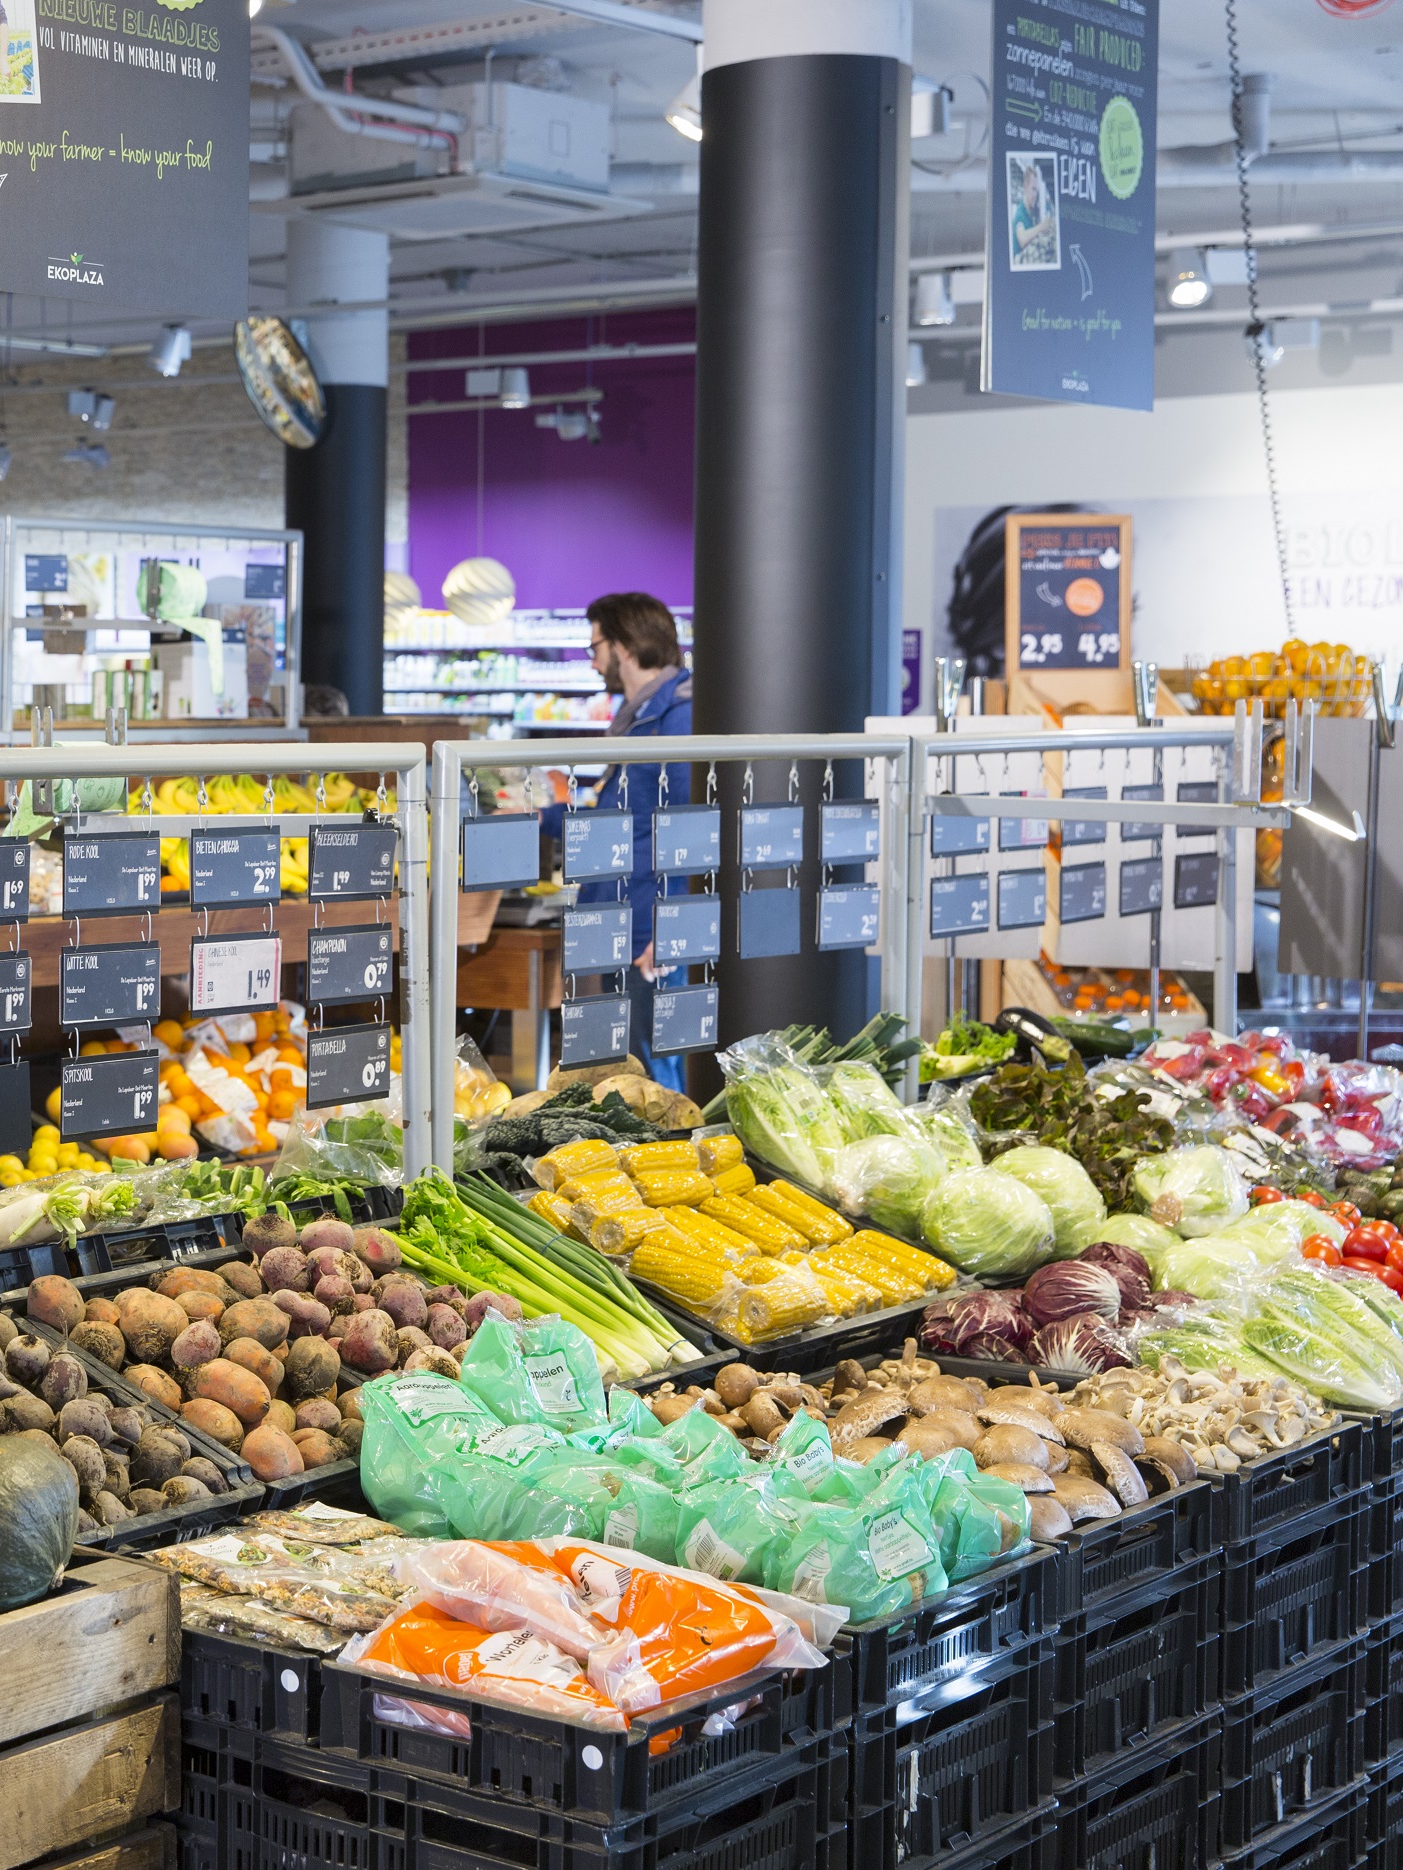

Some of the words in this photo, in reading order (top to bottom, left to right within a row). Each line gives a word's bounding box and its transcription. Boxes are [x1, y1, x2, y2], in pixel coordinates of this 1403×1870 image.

[123, 8, 220, 52] BLAADJES
[39, 27, 55, 49] VOL
[60, 31, 109, 60] VITAMINEN
[114, 42, 124, 64] EN
[128, 45, 176, 73] MINERALEN
[181, 57, 201, 79] WEER
[206, 61, 219, 82] OP.
[28, 144, 57, 171] your
[59, 130, 104, 161] farmer
[120, 133, 151, 166] know
[155, 149, 182, 179] your
[185, 140, 212, 171] food
[1059, 154, 1097, 205] EIGEN
[48, 266, 104, 285] EKOPLAZA
[1020, 633, 1063, 663] 2.95
[1078, 633, 1121, 662] 4.95
[69, 845, 85, 859] RODE
[86, 845, 99, 858] KOOL
[196, 841, 216, 854] BIETEN
[612, 844, 629, 867] 2.99
[68, 875, 87, 883] Nederland
[196, 869, 213, 877] Nederland
[254, 867, 276, 893] 2.99
[334, 871, 350, 891] 1.49
[4, 880, 23, 909] 1.69
[138, 873, 156, 900] 1.99
[208, 947, 227, 958] CHINESE
[228, 946, 237, 956] KOOL
[312, 939, 346, 954] CHAMPIGNON
[613, 936, 626, 960] 1.59
[67, 956, 84, 970] WITTE
[85, 956, 99, 969] KOOL
[248, 969, 270, 1000] 1.49
[364, 962, 388, 988] 0.79
[6, 993, 24, 1022] 1.99
[137, 983, 154, 1010] 1.99
[312, 1040, 346, 1056] PORTABELLA
[612, 1027, 625, 1050] 1.99
[64, 1068, 93, 1083] SPITSKOOL
[362, 1061, 386, 1087] 0.89
[64, 1098, 83, 1107] Nederland
[134, 1091, 152, 1119] 1.99
[794, 1458, 806, 1468] Bio
[805, 1446, 825, 1461] Baby's
[881, 1517, 898, 1533] Baby's
